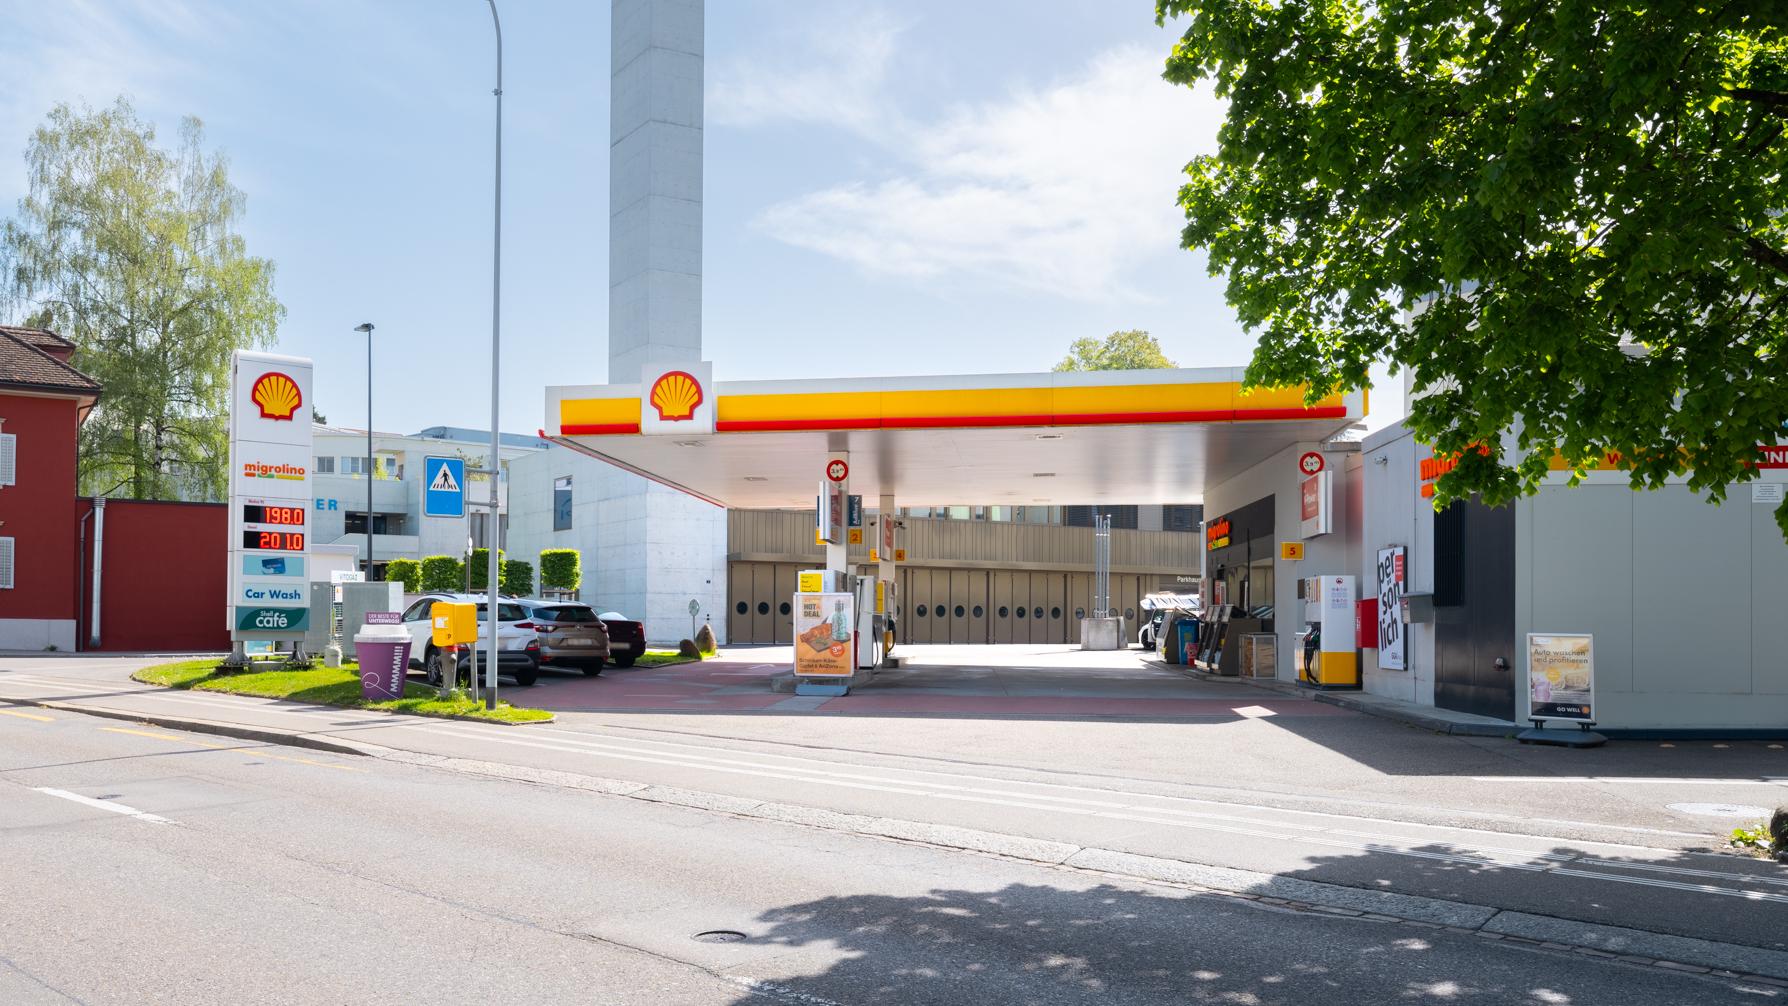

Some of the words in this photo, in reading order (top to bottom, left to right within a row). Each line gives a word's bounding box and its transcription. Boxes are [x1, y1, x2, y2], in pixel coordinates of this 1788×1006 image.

[244, 461, 304, 475] migrolino
[851, 534, 858, 542] 2
[1289, 547, 1296, 556] 5
[1378, 549, 1396, 594] per
[245, 588, 265, 599] Car
[269, 588, 301, 600] Wash
[256, 612, 288, 628] café
[1380, 610, 1399, 652] lich
